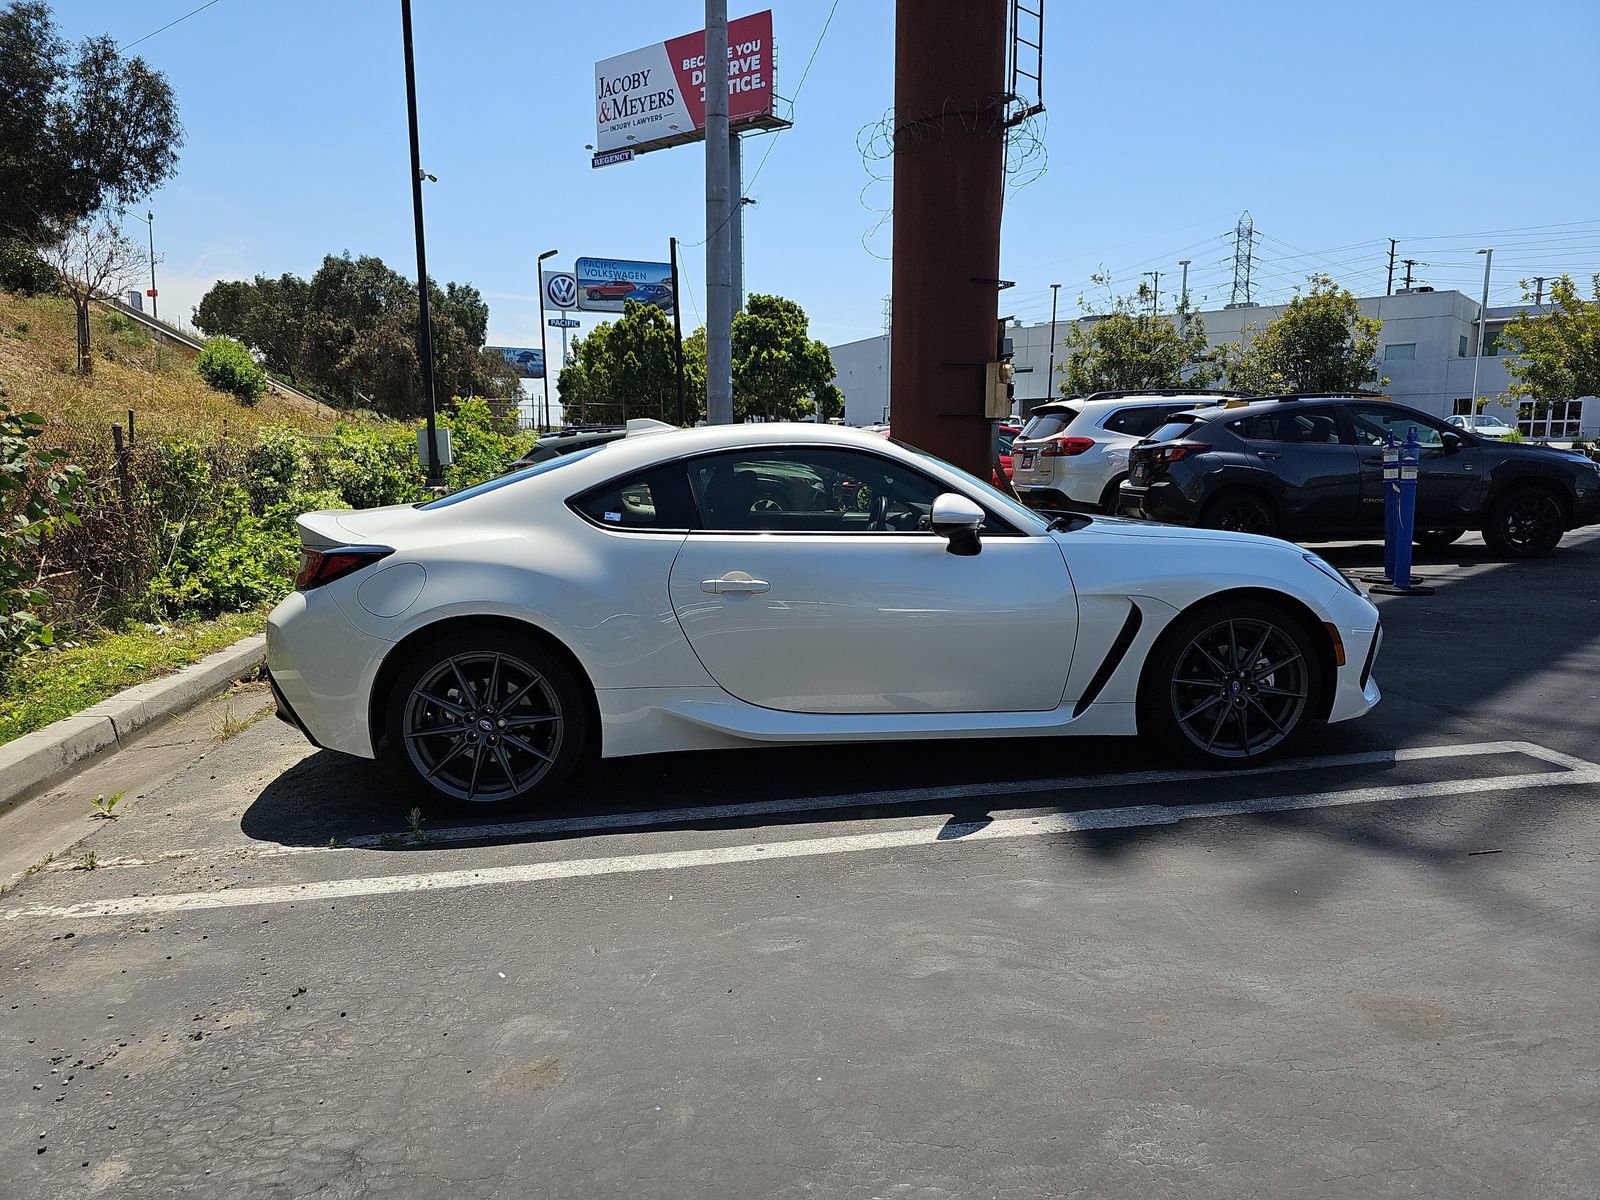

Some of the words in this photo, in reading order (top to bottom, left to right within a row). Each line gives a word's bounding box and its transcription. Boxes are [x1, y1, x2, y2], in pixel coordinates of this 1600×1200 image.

[682, 47, 733, 70] BECE
[736, 40, 760, 56] YOU
[692, 54, 761, 86] DRVE
[599, 69, 651, 99] JACOBY
[700, 73, 766, 102] JTICE.
[609, 121, 631, 133] INJURY
[632, 113, 663, 126] LAWYERS
[593, 152, 630, 166] REGENCY
[583, 260, 617, 269] PACIFIC
[584, 269, 647, 280] VOLKSWAGEN
